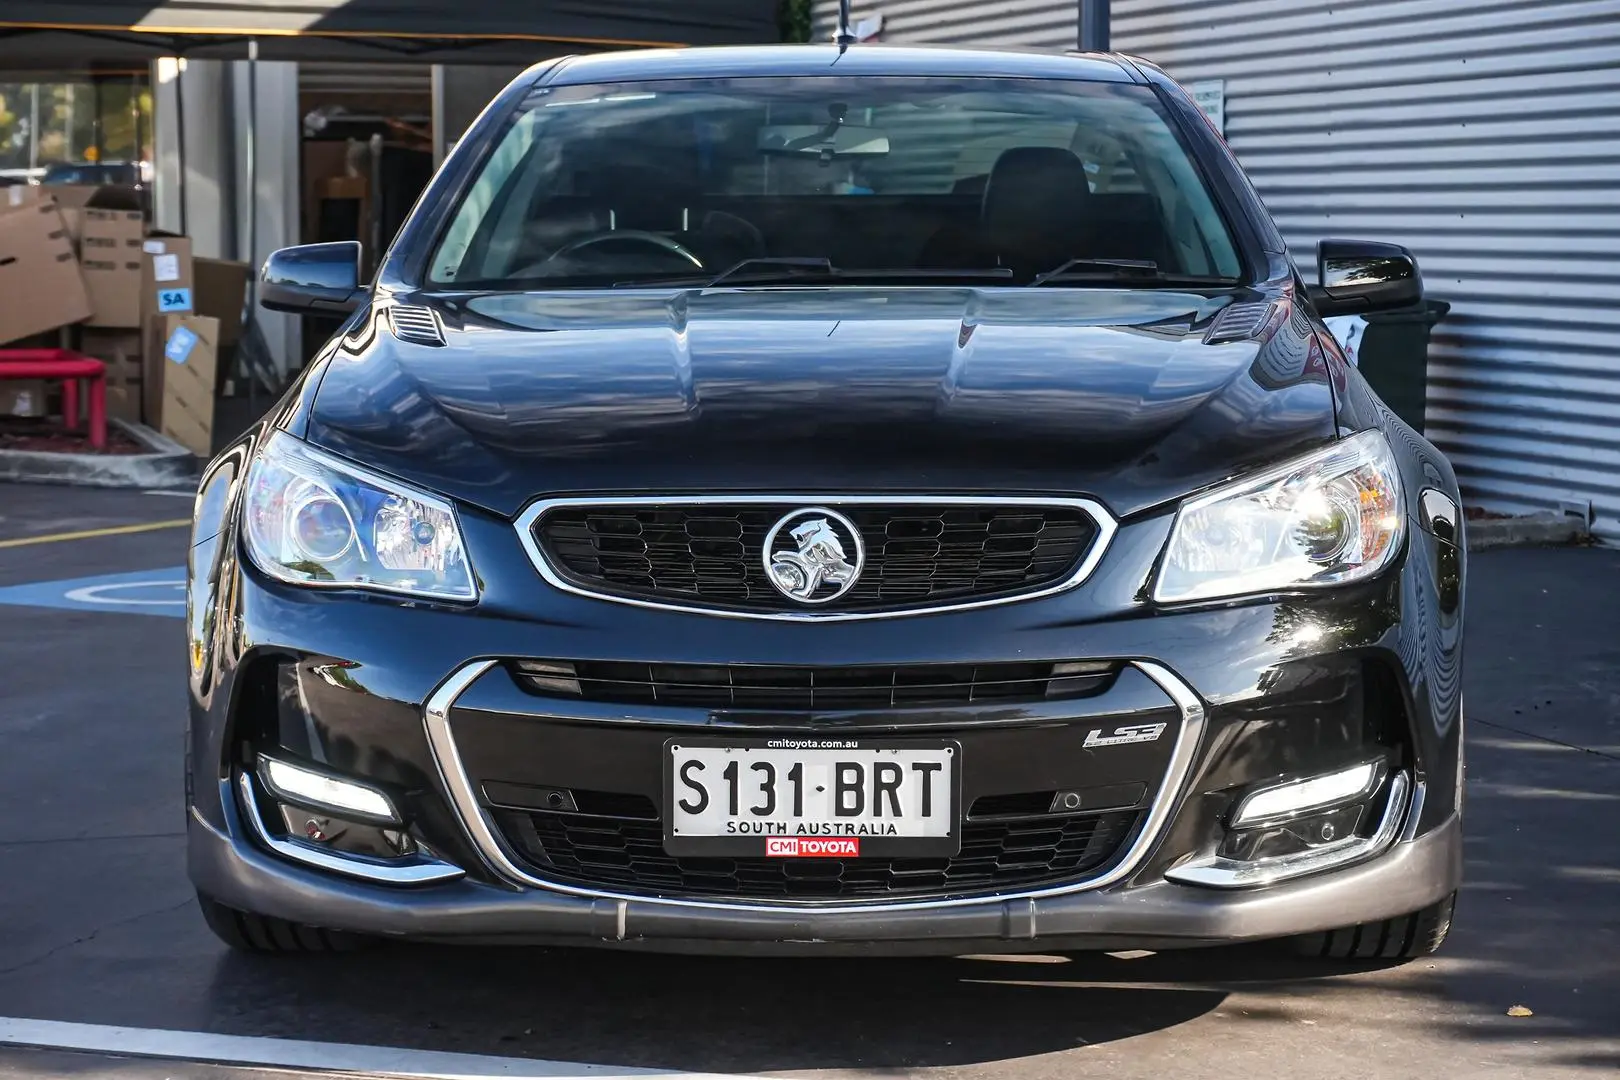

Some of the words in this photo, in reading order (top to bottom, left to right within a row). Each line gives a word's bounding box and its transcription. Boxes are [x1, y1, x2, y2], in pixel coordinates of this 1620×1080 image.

[163, 293, 185, 305] SA
[1083, 722, 1167, 742] LS3
[767, 739, 858, 749] cmitoyota.com.au
[727, 821, 787, 834] SOUTH
[796, 823, 897, 835] AUSTRALIA
[770, 841, 796, 853] CMI
[800, 841, 857, 853] TOYOTA
